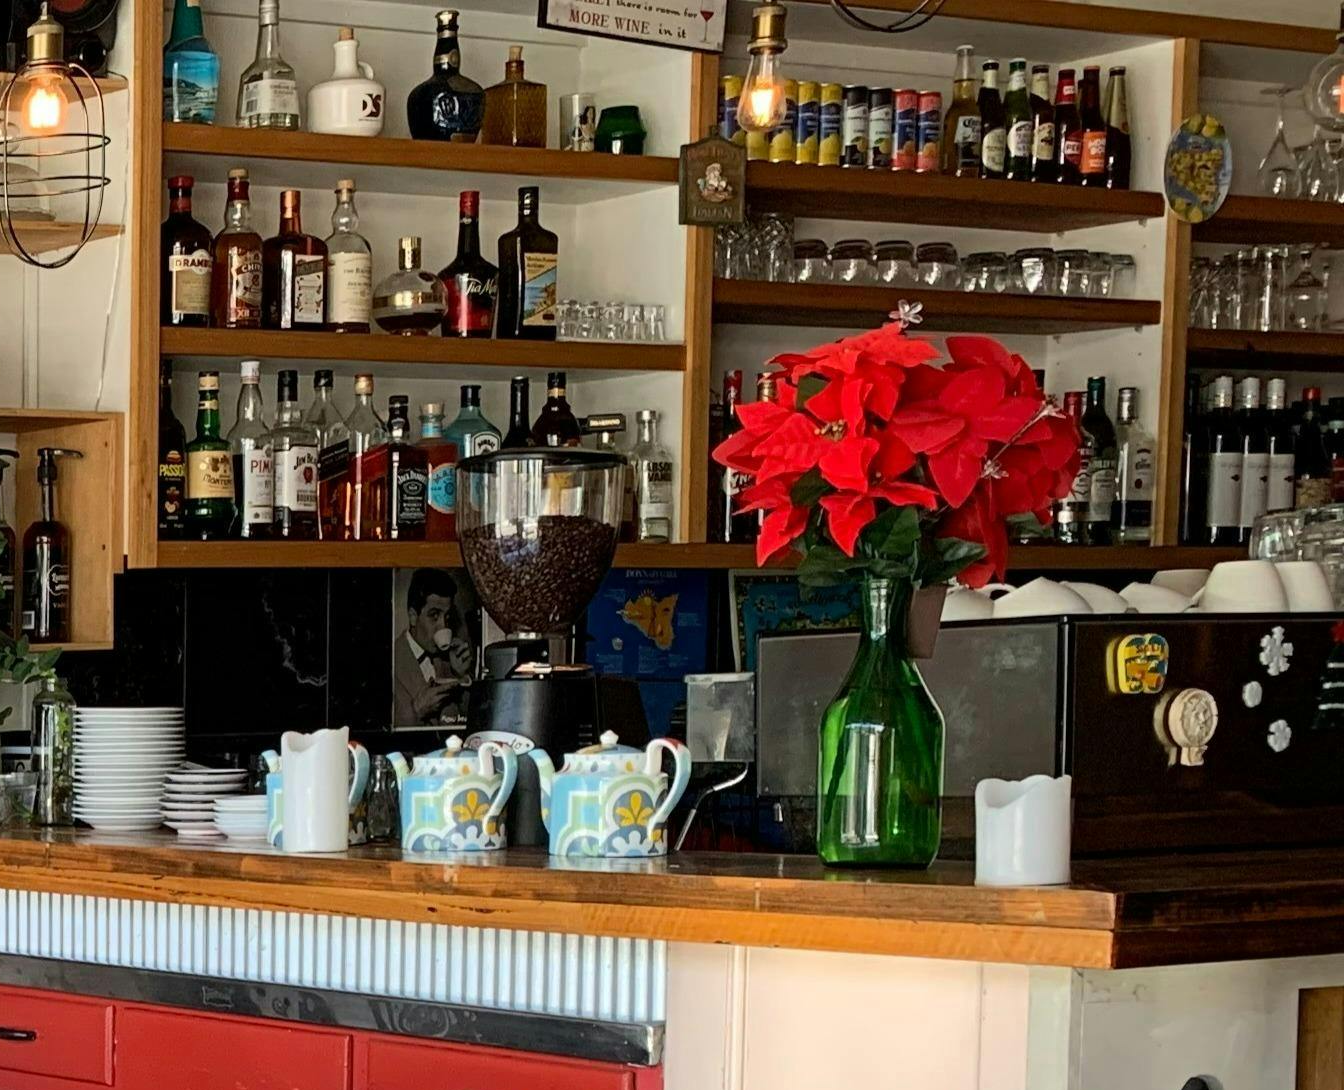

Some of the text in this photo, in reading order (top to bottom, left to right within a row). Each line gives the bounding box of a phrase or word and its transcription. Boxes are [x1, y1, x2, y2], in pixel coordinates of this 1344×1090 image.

[569, 9, 686, 38] MORE WINE in it
[656, 8, 680, 16] room
[684, 9, 697, 19] for
